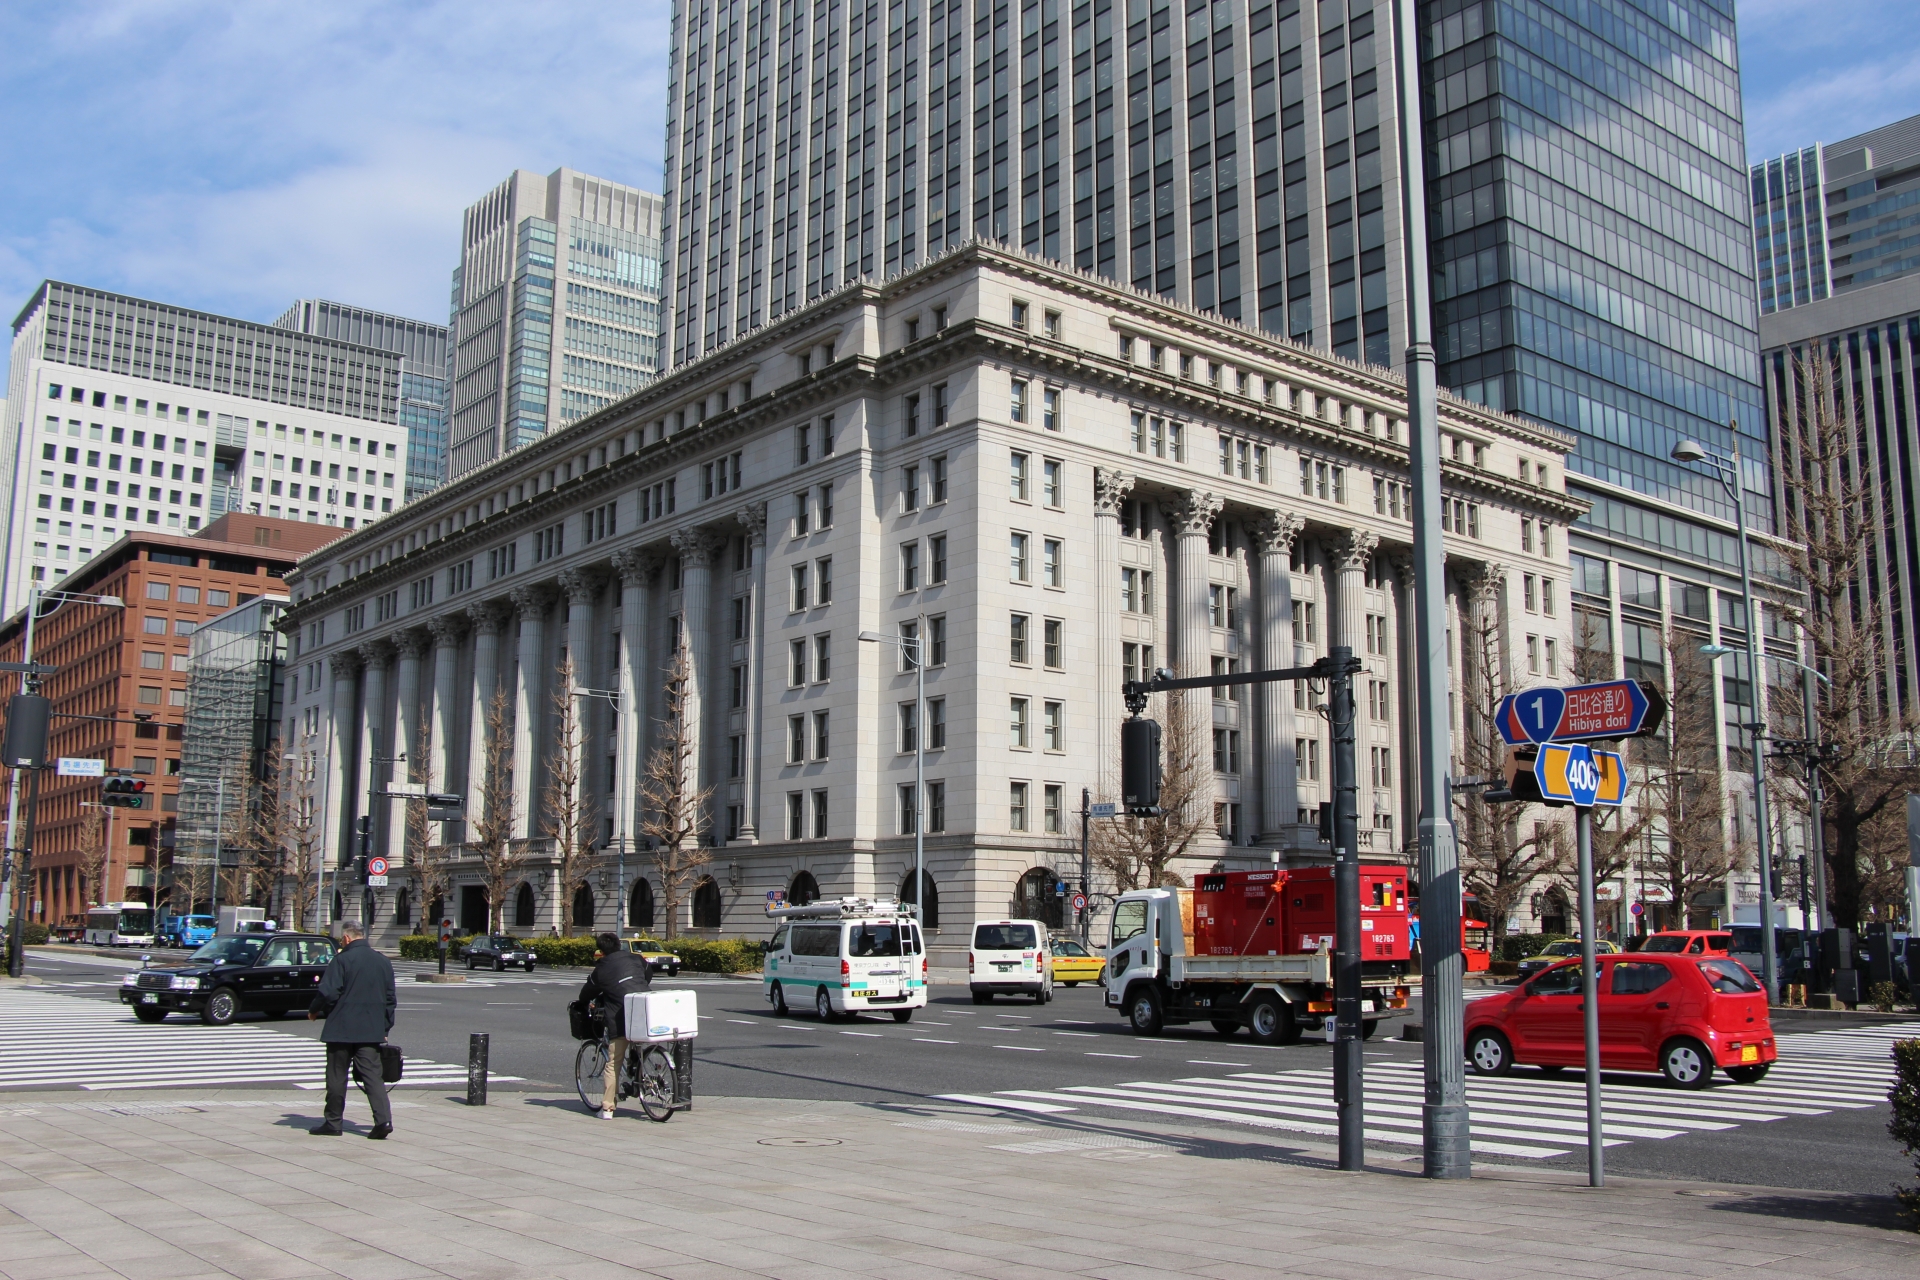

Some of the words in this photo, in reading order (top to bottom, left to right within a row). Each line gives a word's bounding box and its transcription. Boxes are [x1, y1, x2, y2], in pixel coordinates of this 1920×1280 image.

[1531, 696, 1544, 730] 1
[1568, 689, 1625, 717] 日比谷通り
[1569, 718, 1602, 732] Hibiya
[1605, 713, 1627, 728] dori
[1569, 759, 1597, 791] 406
